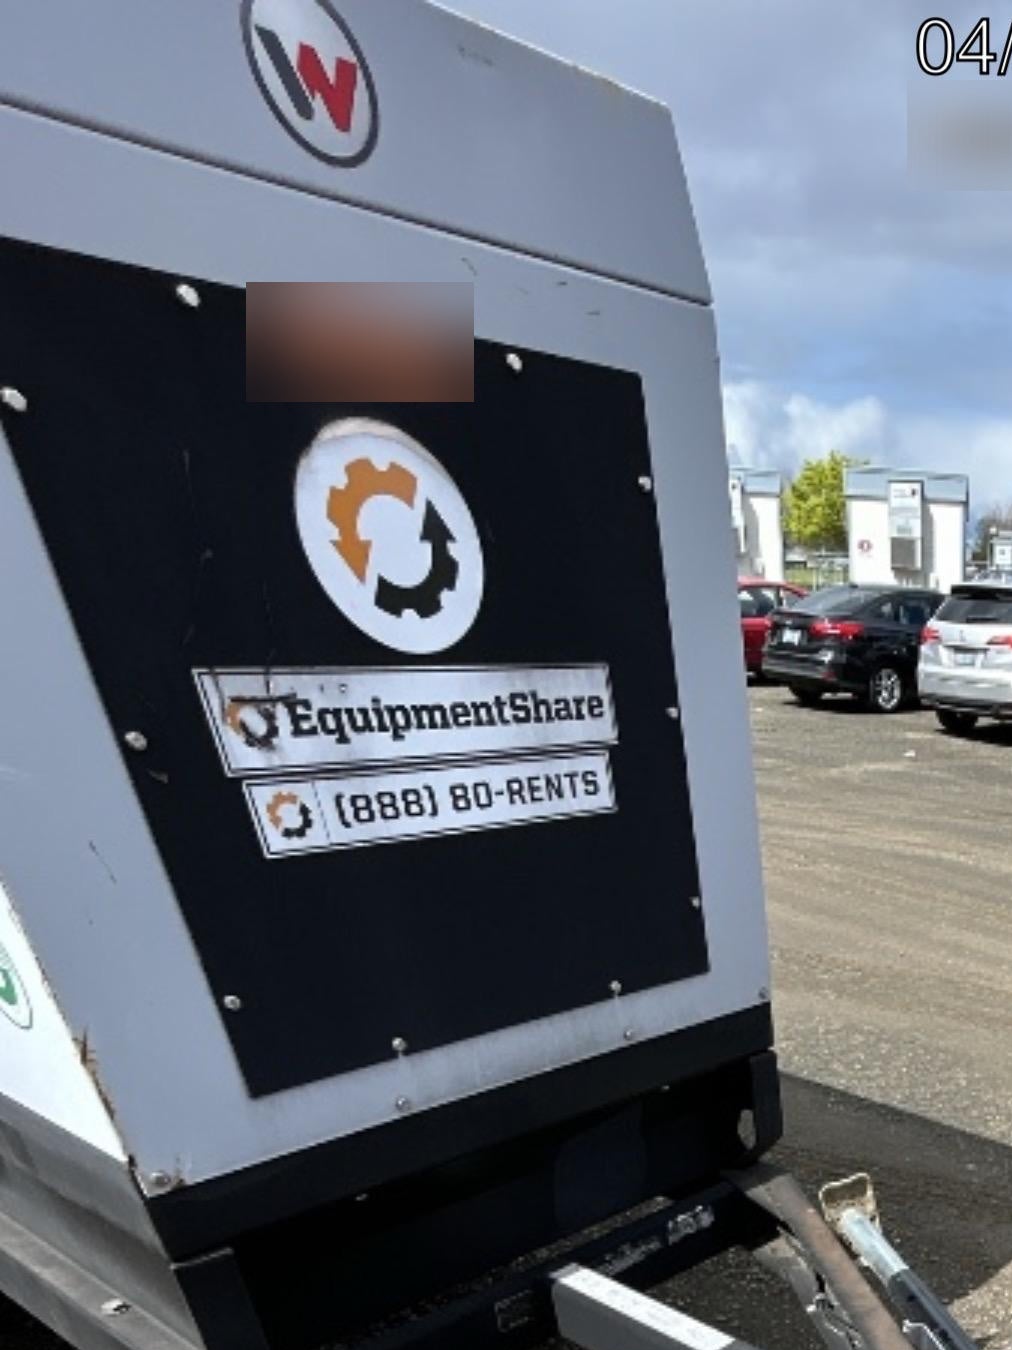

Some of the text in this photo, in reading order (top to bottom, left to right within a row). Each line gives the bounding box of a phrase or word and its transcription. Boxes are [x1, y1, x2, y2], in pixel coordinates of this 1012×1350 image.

[290, 691, 605, 743] EquipmentShare
[334, 770, 601, 828] (888) 80-RENTS
